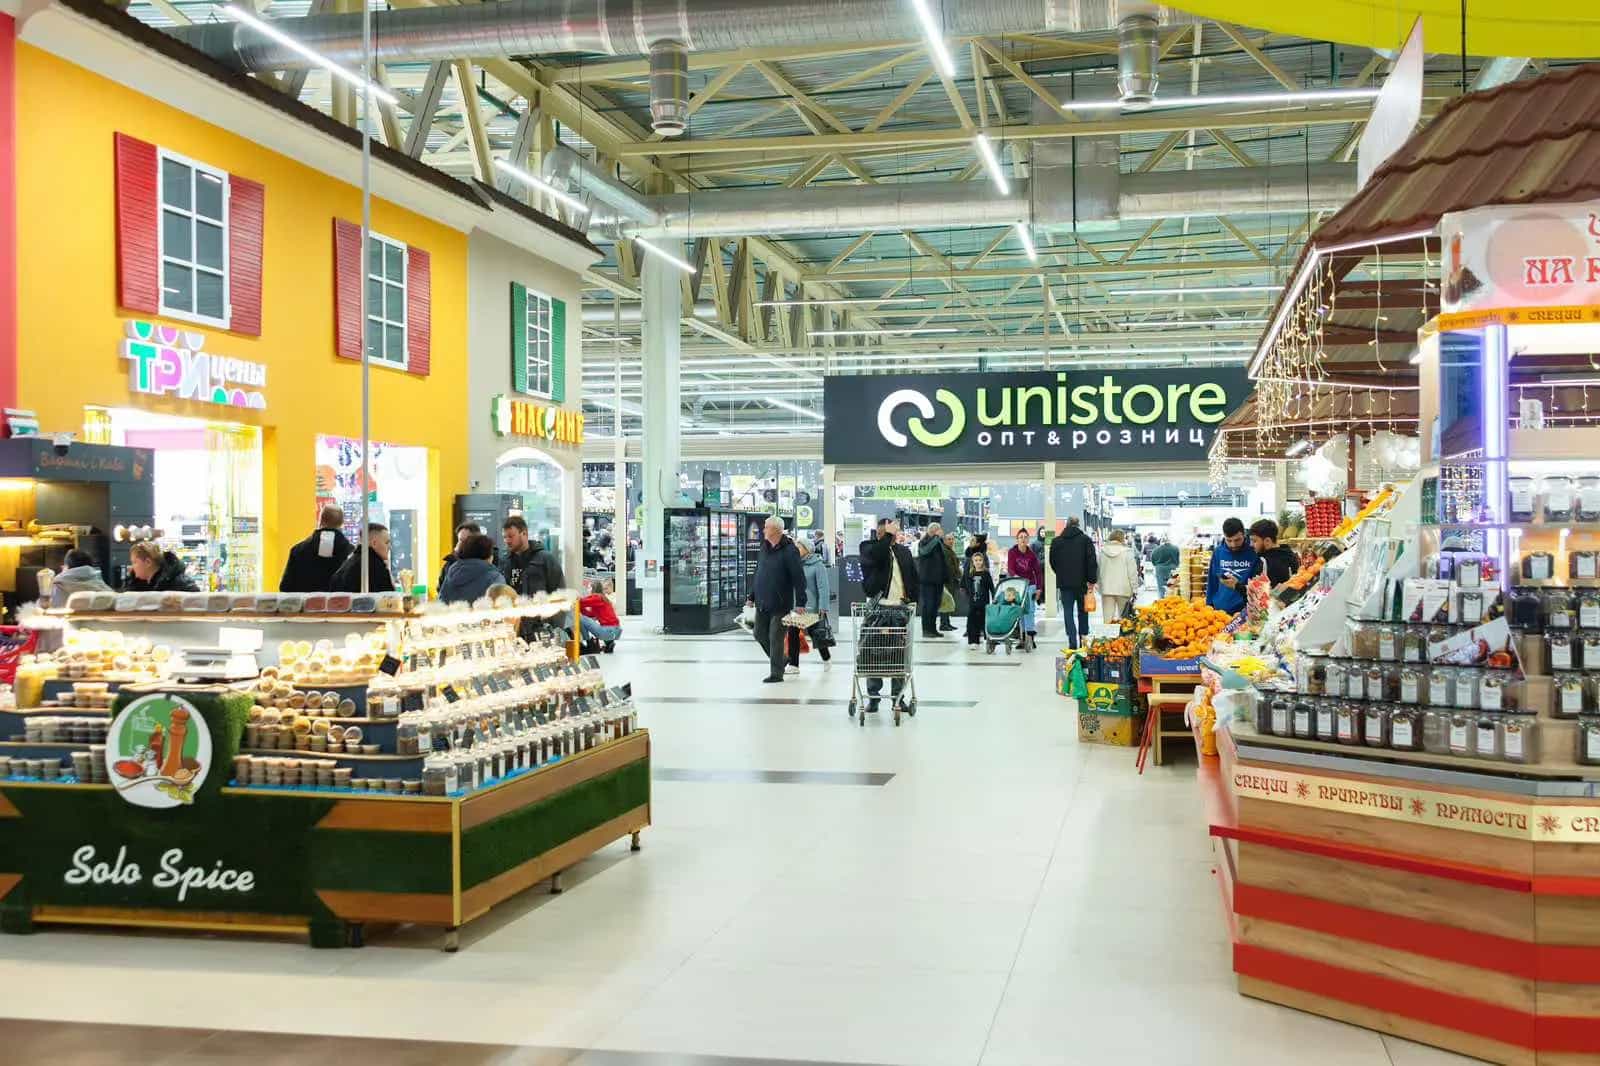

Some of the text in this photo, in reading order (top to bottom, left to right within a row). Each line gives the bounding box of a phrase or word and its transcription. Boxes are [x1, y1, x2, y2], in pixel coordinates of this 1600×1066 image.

[1525, 259, 1574, 284] НА
[124, 338, 210, 398] ТРИ
[976, 372, 1227, 427] unistore
[977, 428, 1217, 449] опт & розниц
[1234, 773, 1527, 830] СПЕЦИИ ПРИПРАВЫ ПРЯНОСТИ
[64, 844, 256, 902] Solo Spice
